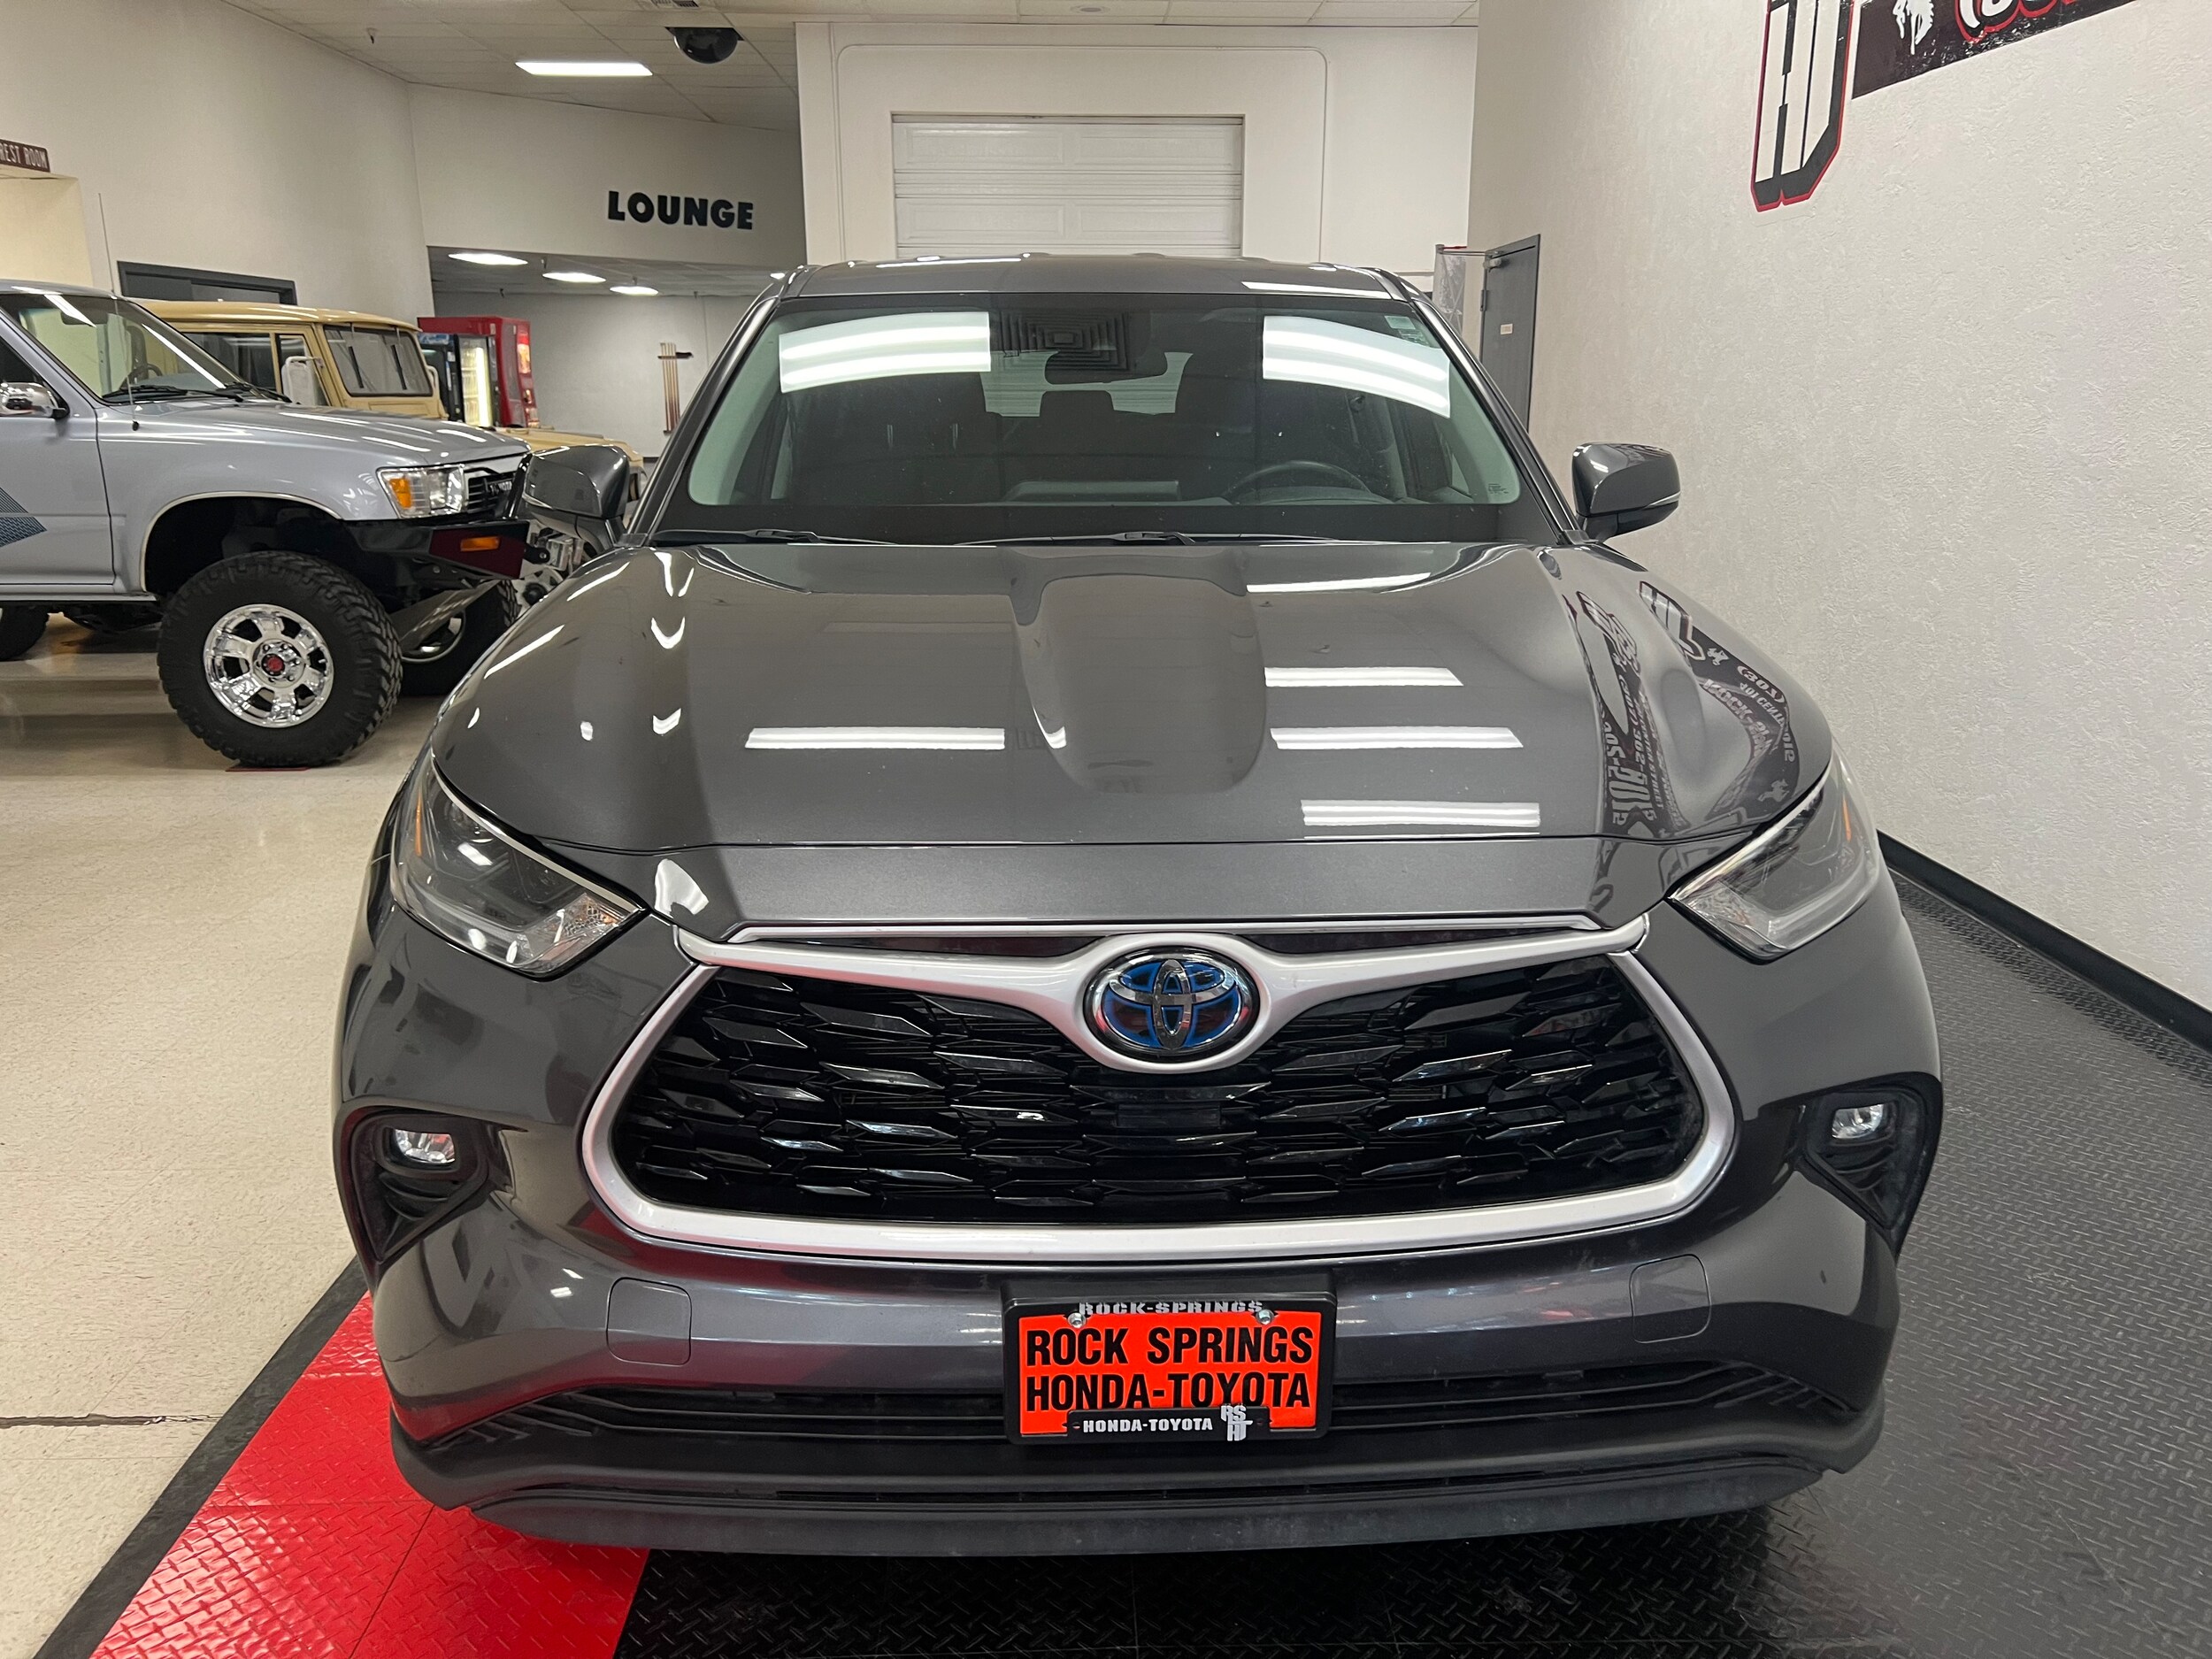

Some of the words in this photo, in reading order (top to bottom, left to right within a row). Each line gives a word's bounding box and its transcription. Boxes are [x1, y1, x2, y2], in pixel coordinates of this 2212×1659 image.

[23, 146, 48, 168] ROOM
[608, 190, 754, 230] LOUNGE
[1079, 1301, 1263, 1316] ROCK-SPRINGS
[1027, 1327, 1129, 1366] ROCK
[1148, 1326, 1312, 1364] SPRINGS
[1026, 1372, 1311, 1411] HONDA-TOYOTA
[1083, 1417, 1213, 1432] HONDA-TOYOTA
